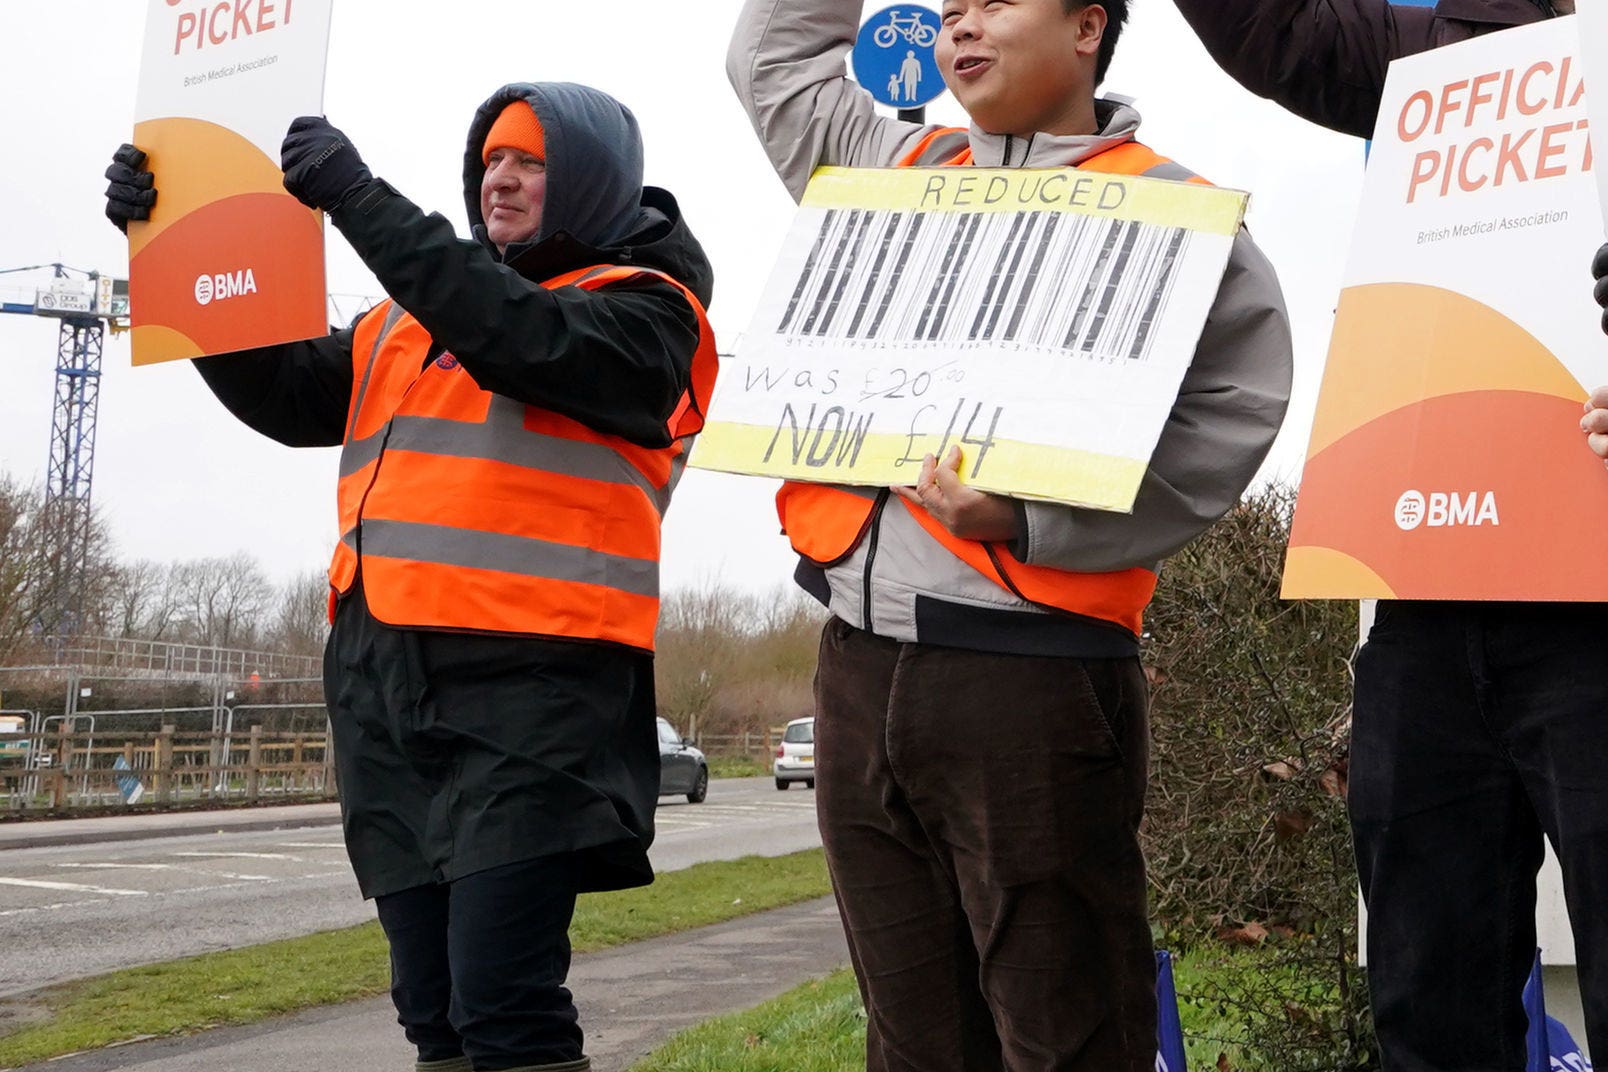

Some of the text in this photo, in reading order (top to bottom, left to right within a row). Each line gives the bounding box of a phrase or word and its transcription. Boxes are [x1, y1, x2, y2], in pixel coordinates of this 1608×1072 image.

[183, 54, 279, 88] British Medical Association
[920, 174, 1127, 210] REDUCED
[1416, 209, 1569, 245] British Medical Association
[214, 268, 258, 300] BMA
[762, 397, 1003, 479] NOW £14
[1427, 490, 1500, 527] BMA
